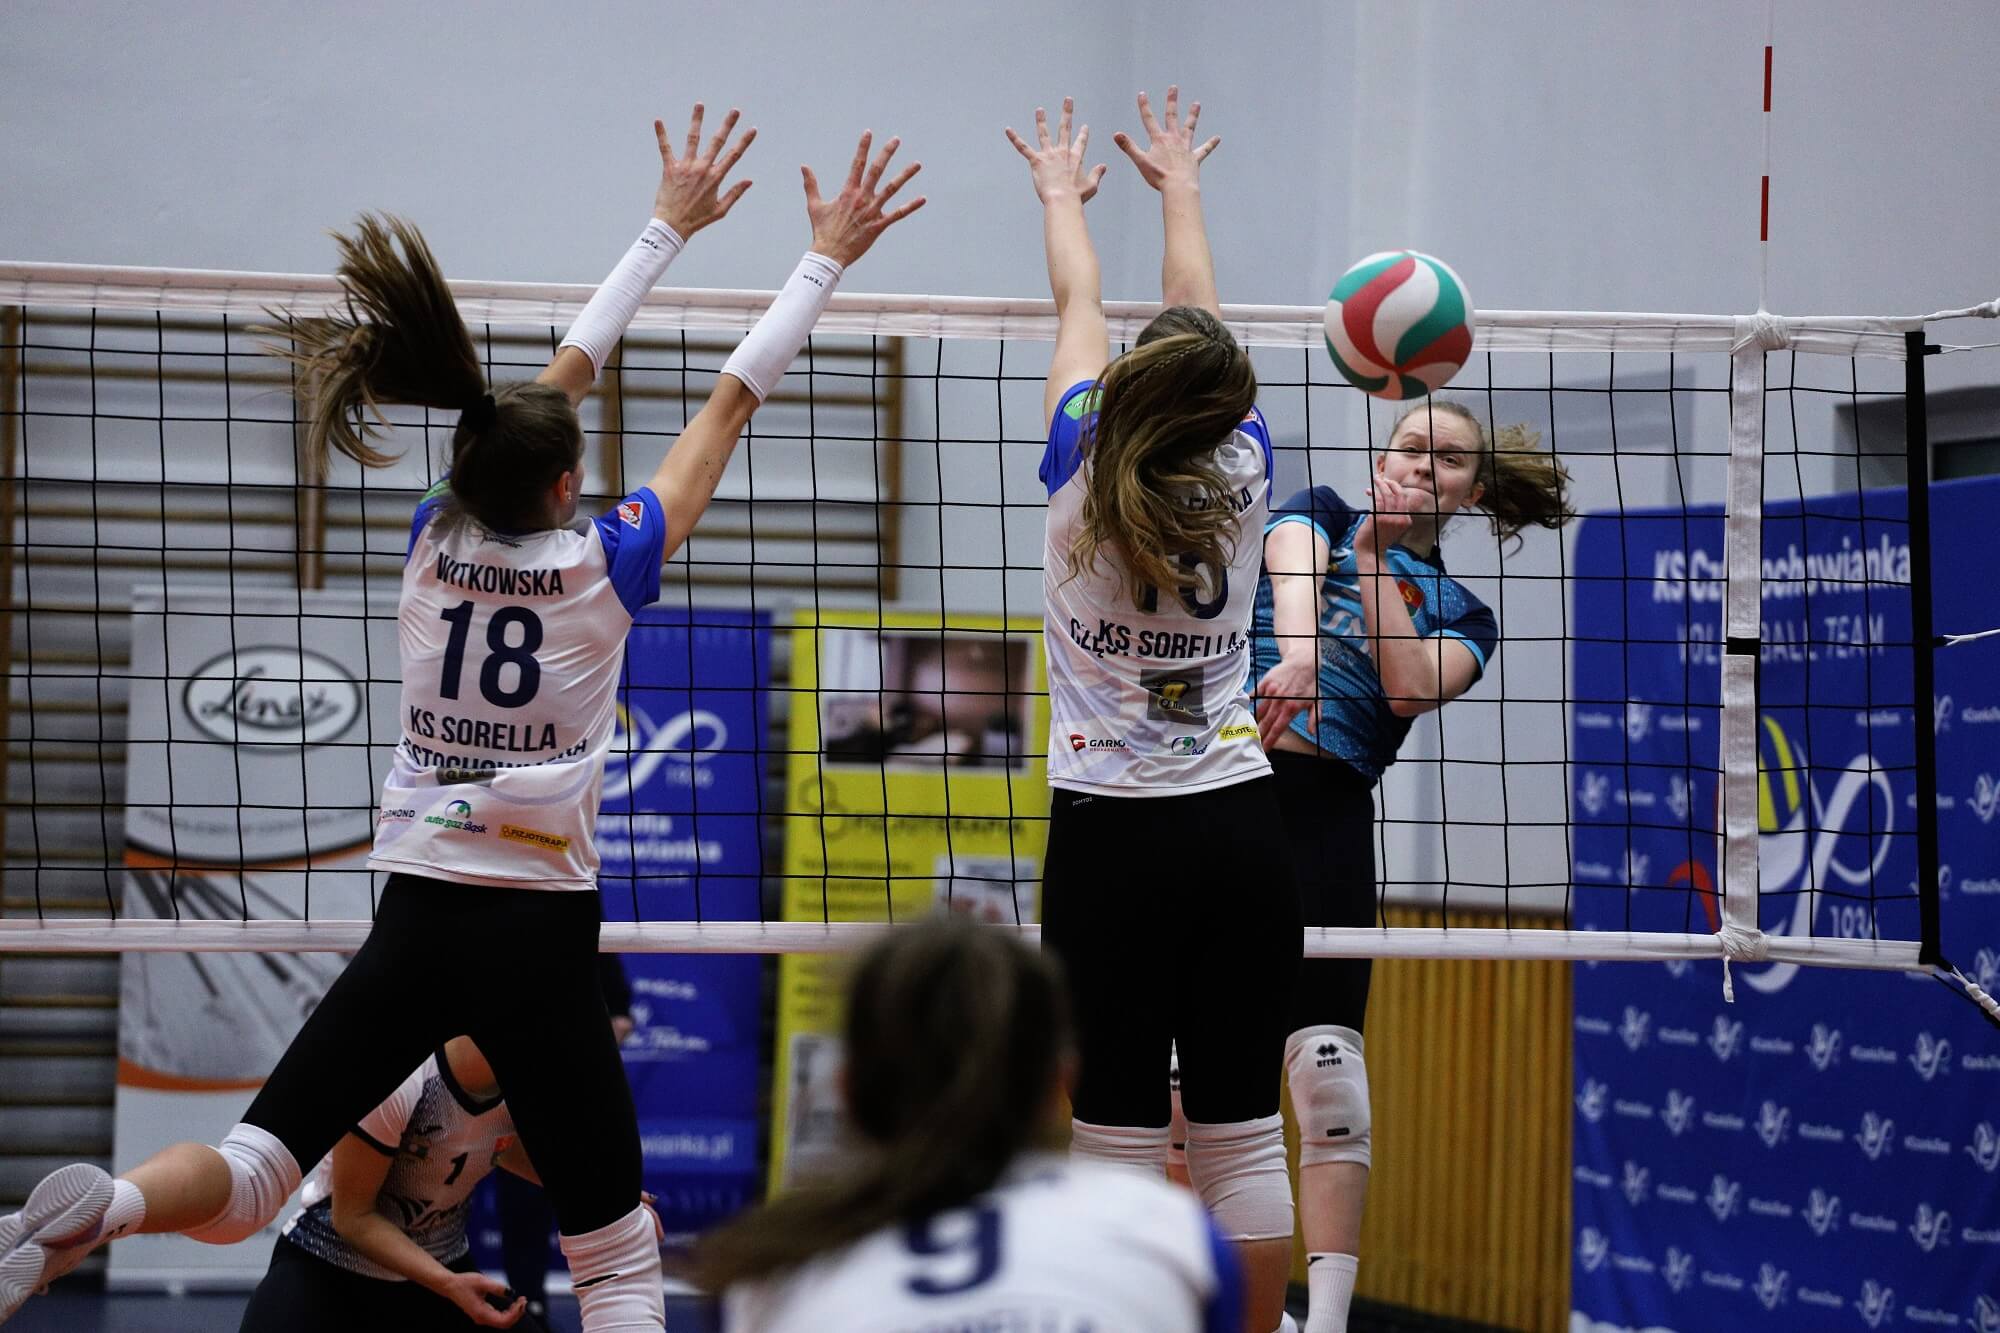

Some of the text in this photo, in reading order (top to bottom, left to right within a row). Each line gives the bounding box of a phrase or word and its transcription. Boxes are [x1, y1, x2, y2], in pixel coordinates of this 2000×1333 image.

[436, 552, 564, 596] WITKOWSKA
[440, 600, 543, 708] 18
[1099, 618, 1131, 651] KS
[1824, 611, 1886, 661] TEAM
[410, 705, 434, 739] KS
[441, 716, 557, 753] SORELLA
[443, 1151, 469, 1185] 1
[904, 1198, 1006, 1296] 9
